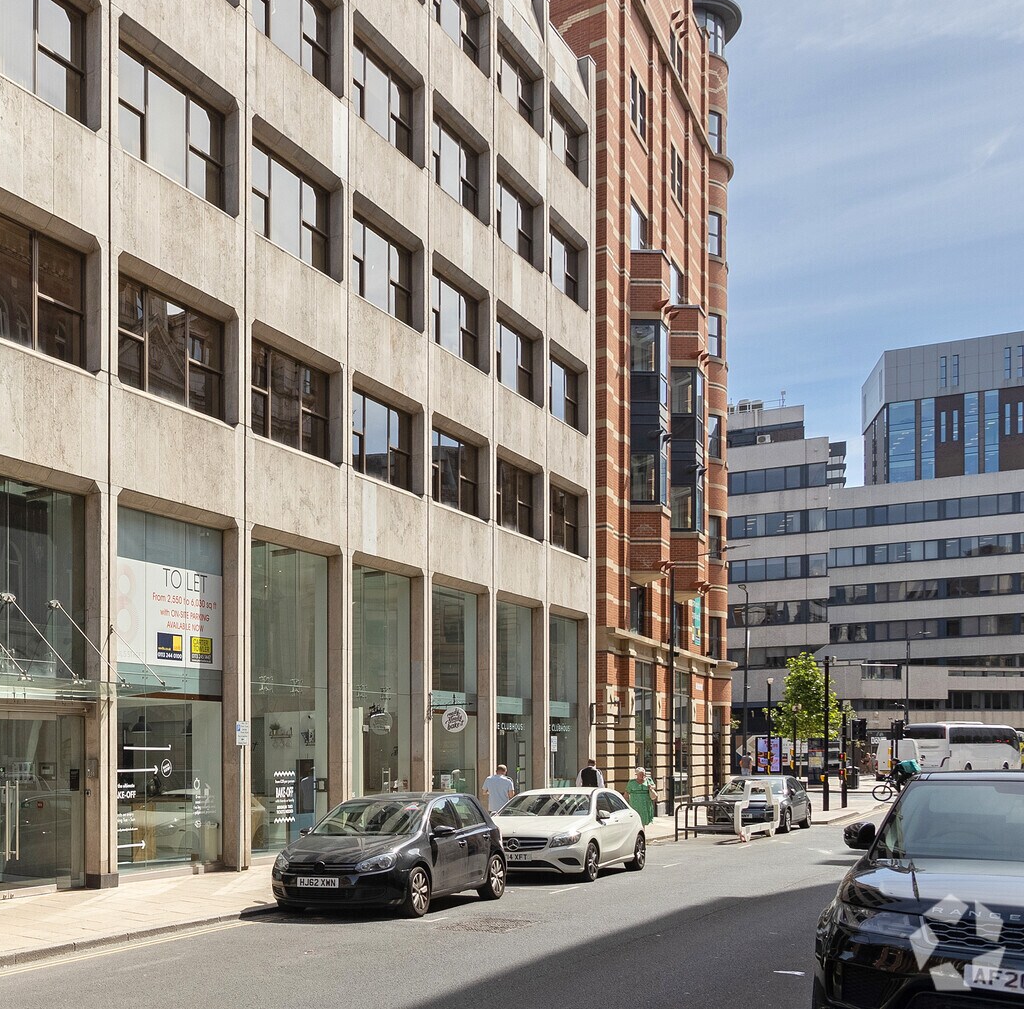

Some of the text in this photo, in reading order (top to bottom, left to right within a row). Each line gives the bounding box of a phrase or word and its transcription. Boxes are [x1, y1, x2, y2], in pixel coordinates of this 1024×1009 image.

[163, 567, 208, 594] TO LET
[152, 592, 167, 602] From
[183, 598, 190, 606] to
[205, 601, 213, 611] sq
[170, 609, 189, 620] ON-SITE
[189, 612, 210, 622] PARKING
[166, 620, 205, 632] AVAILABLE NOW
[116, 790, 136, 799] KE-OFF
[299, 878, 336, 887] HJ62 XWN
[932, 907, 1022, 922] RANGE
